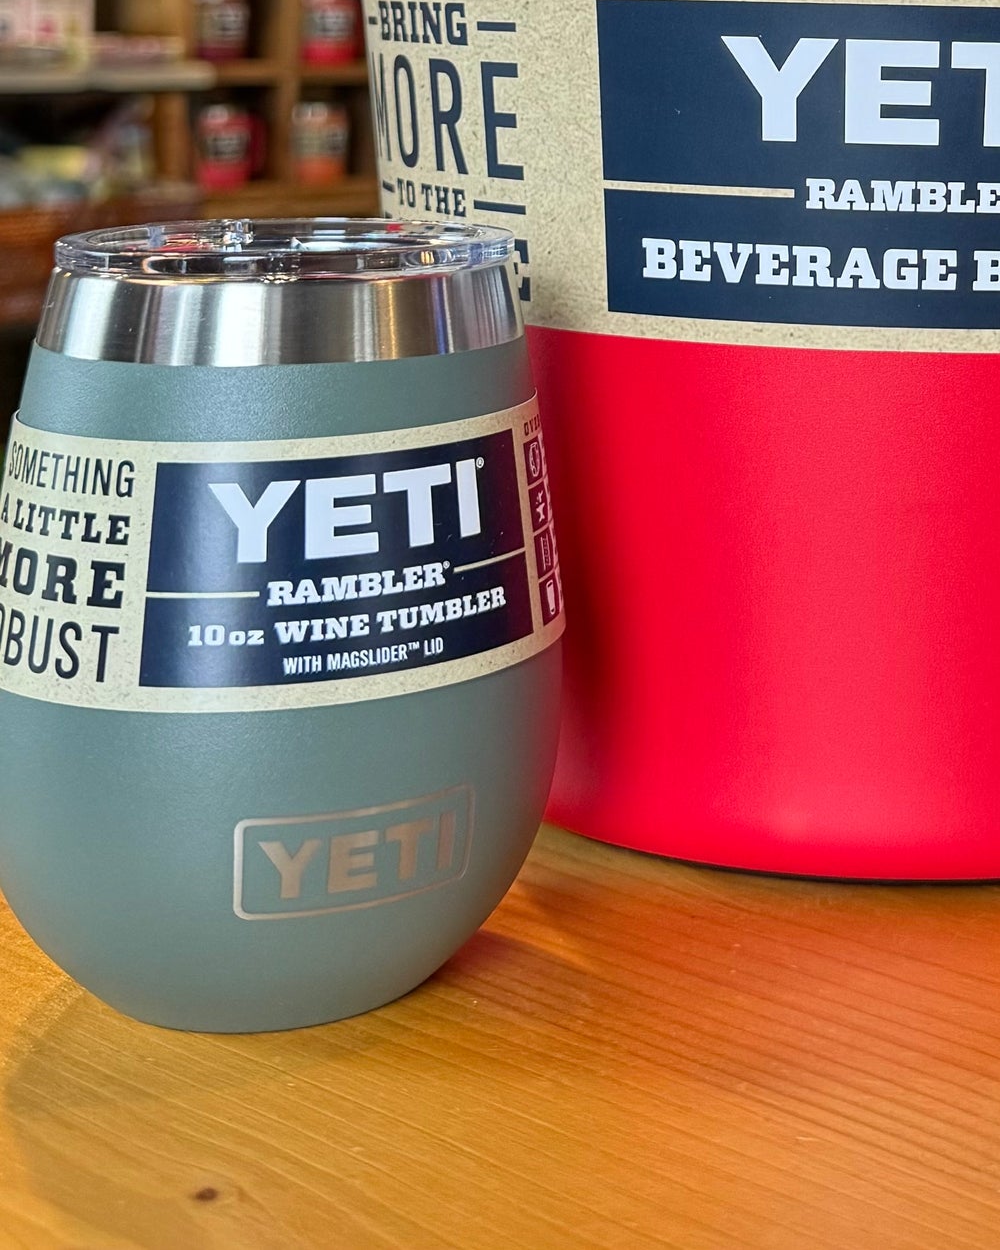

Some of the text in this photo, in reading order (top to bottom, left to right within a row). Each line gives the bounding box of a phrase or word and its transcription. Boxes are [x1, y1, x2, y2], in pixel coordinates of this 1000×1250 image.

[378, 0, 468, 46] BRING
[372, 52, 525, 182] MORE
[397, 177, 467, 218] TO THE
[641, 237, 957, 293] BEVERAGE
[8, 440, 135, 498] SOMETHING
[1, 493, 131, 546] A LITTLE
[187, 586, 506, 647] 10 oz WINE TUMBLER
[283, 654, 322, 676] WITH
[424, 636, 444, 656] LID
[257, 810, 456, 899] YETI
